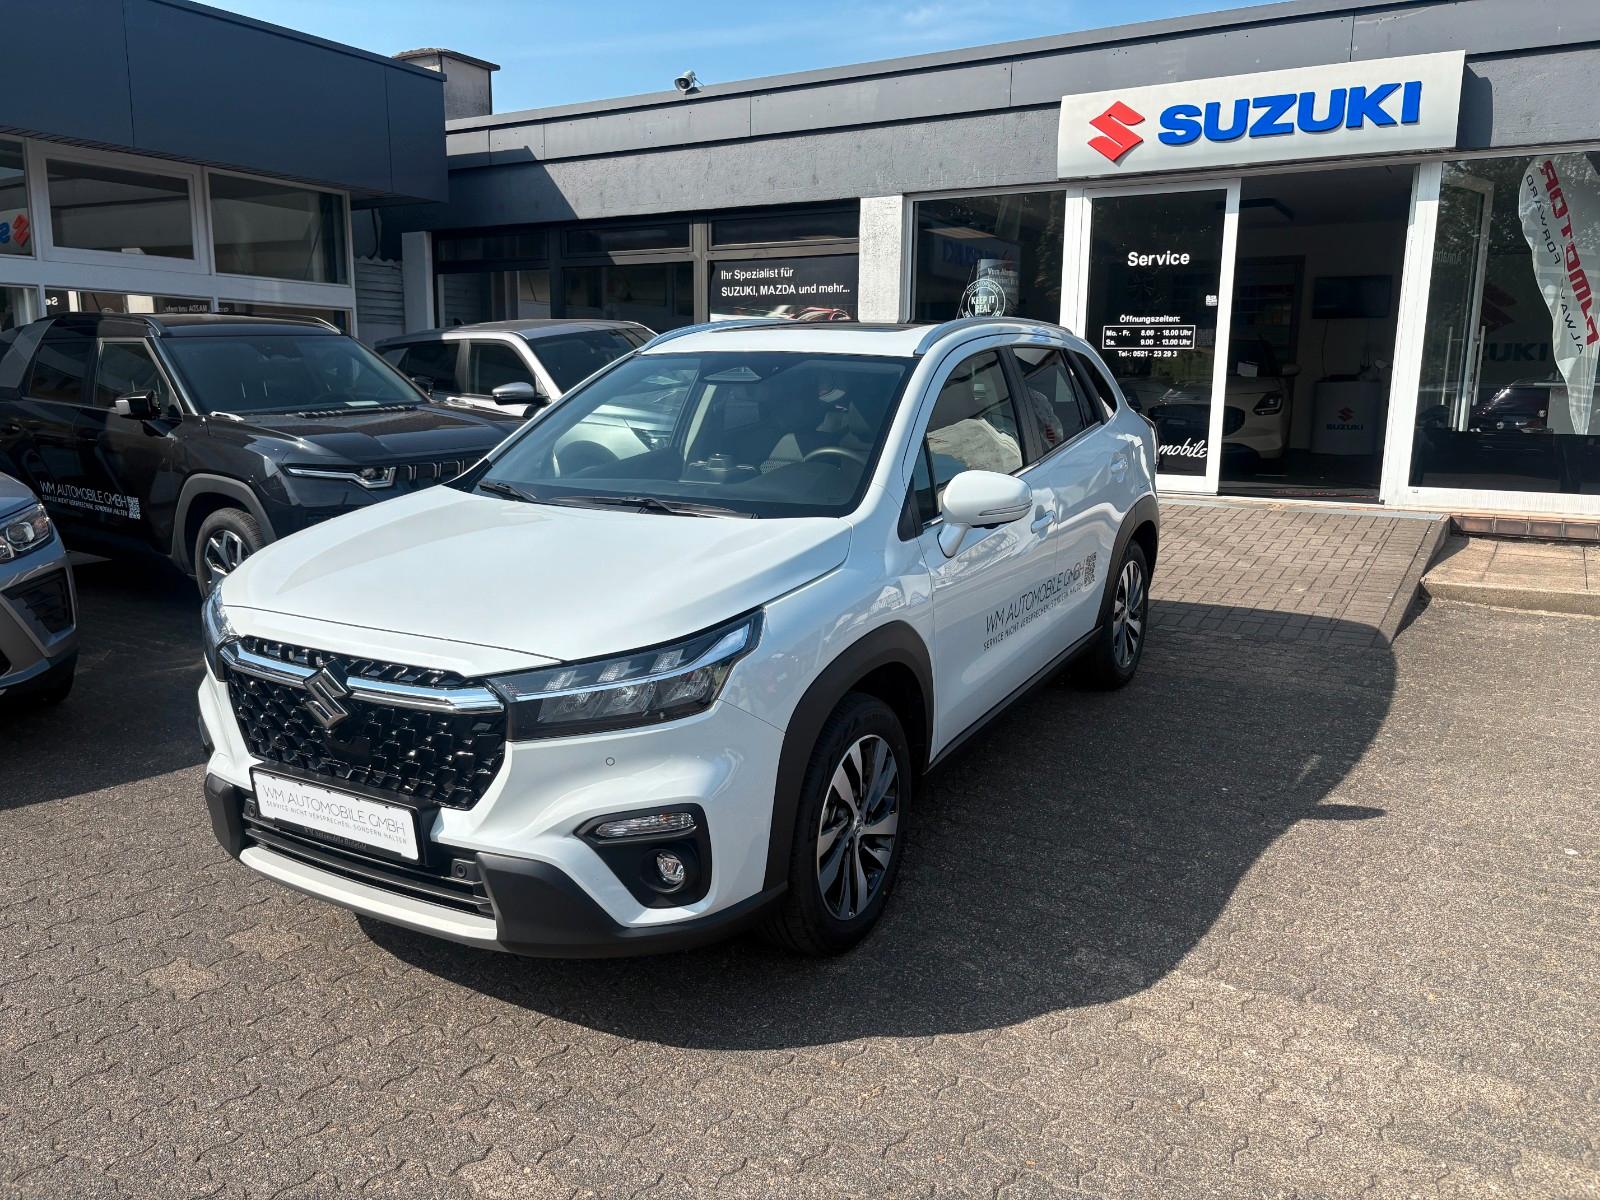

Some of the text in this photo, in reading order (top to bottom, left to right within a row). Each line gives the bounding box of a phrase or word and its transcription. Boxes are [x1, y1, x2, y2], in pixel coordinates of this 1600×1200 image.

[1158, 80, 1422, 146] SUZUKI
[1127, 251, 1190, 267] Service
[721, 267, 794, 281] Ihr Spezialist für
[721, 283, 850, 297] SUZUKI, MAZDA und mehr...
[971, 296, 988, 305] KEEP
[975, 304, 991, 314] REAL
[1120, 314, 1180, 324] Öffnungszeiten:
[40, 480, 56, 494] WM
[57, 484, 104, 503] AUTOMOBILE
[986, 608, 1005, 635] WM
[1005, 572, 1064, 627] AUTOMOBILE
[983, 631, 1004, 651] SERVICE
[263, 785, 285, 802] WM
[288, 793, 367, 825] AUTOMOBILE
